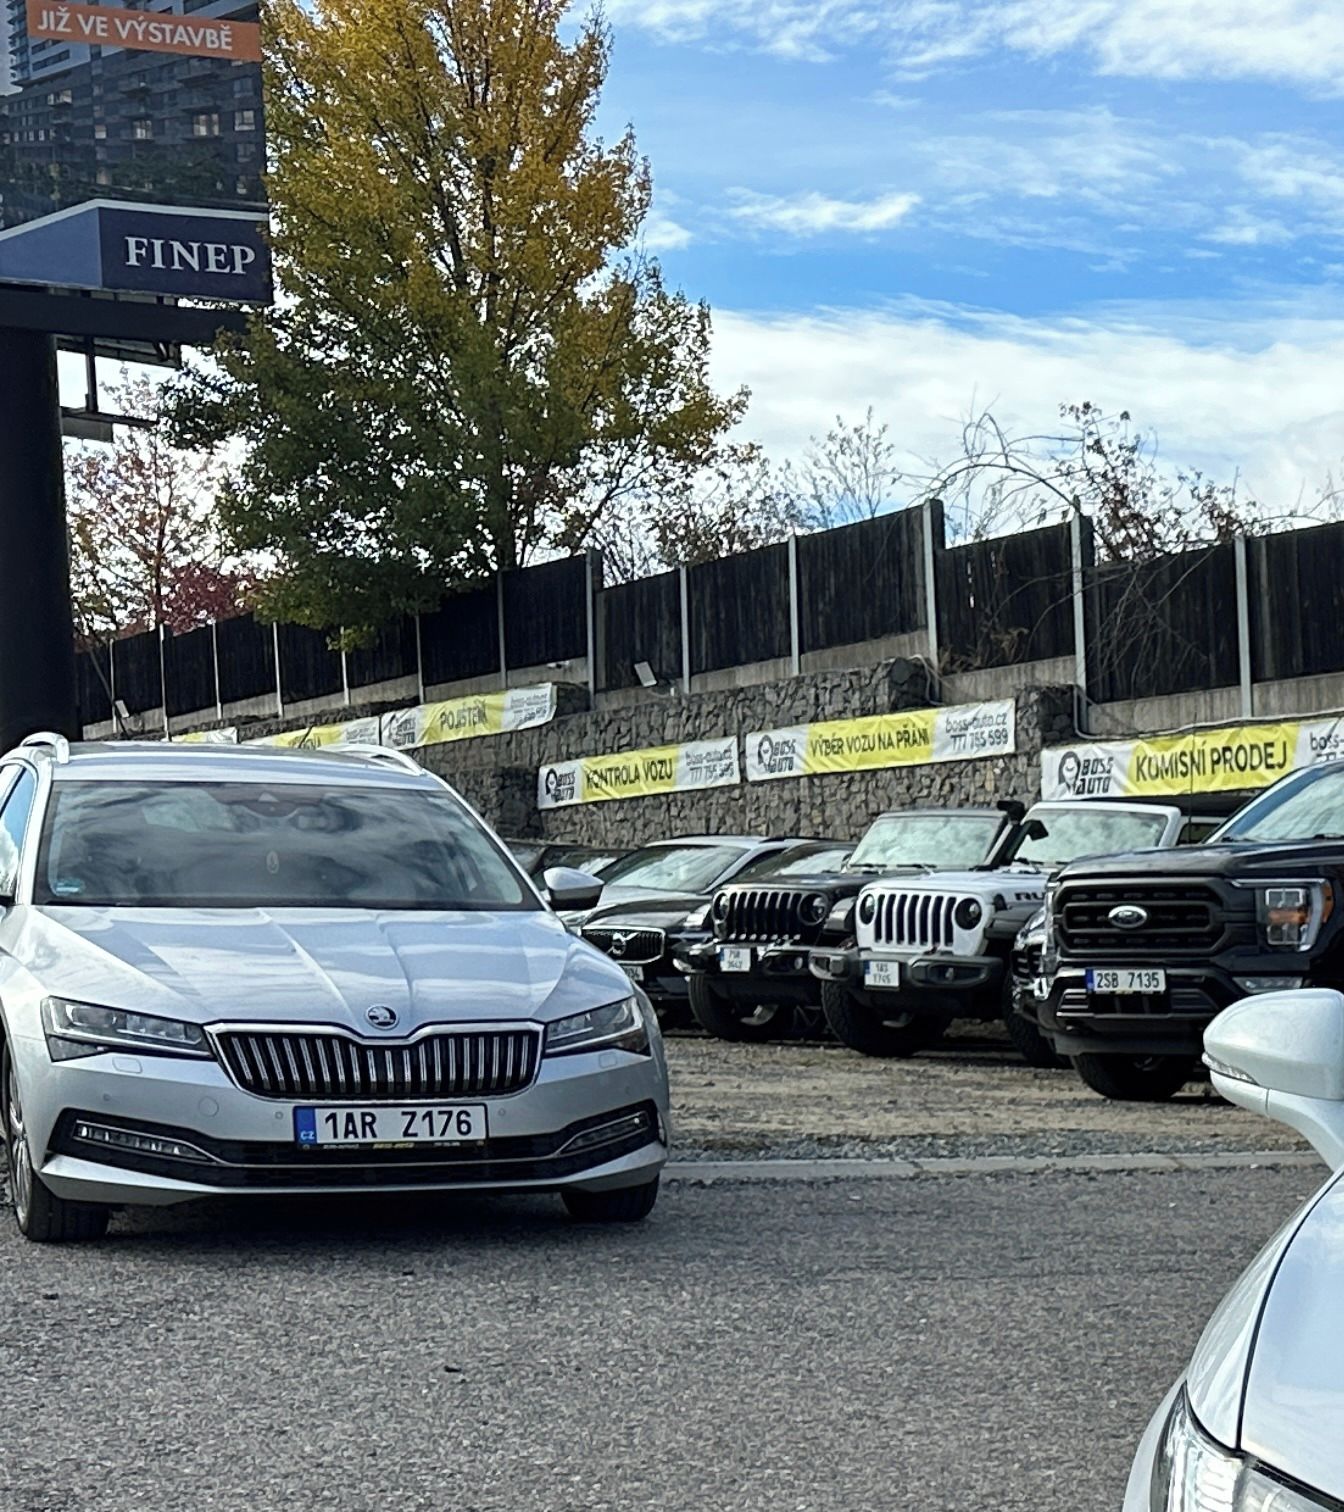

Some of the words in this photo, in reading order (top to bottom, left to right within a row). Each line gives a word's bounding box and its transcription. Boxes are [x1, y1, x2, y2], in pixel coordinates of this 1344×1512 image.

[38, 6, 72, 33] JIŽ
[77, 14, 109, 37] VE
[114, 15, 233, 51] VÝSTAVBĚ
[124, 236, 256, 275] FINEP
[846, 733, 876, 755] VOZU
[877, 733, 896, 751] NA
[586, 765, 640, 789] KONTROLA
[642, 758, 673, 782] VOZU
[1081, 756, 1114, 777] BOSS
[1135, 745, 1207, 782] KOMISNÍ
[1211, 741, 1287, 775] PRODEJ
[1075, 776, 1112, 795] AUTO
[1096, 971, 1119, 989] 2SB
[1128, 971, 1160, 989] 7135
[300, 1131, 316, 1141] CZ
[325, 1111, 378, 1140] 1AR
[401, 1109, 472, 1138] Z176
